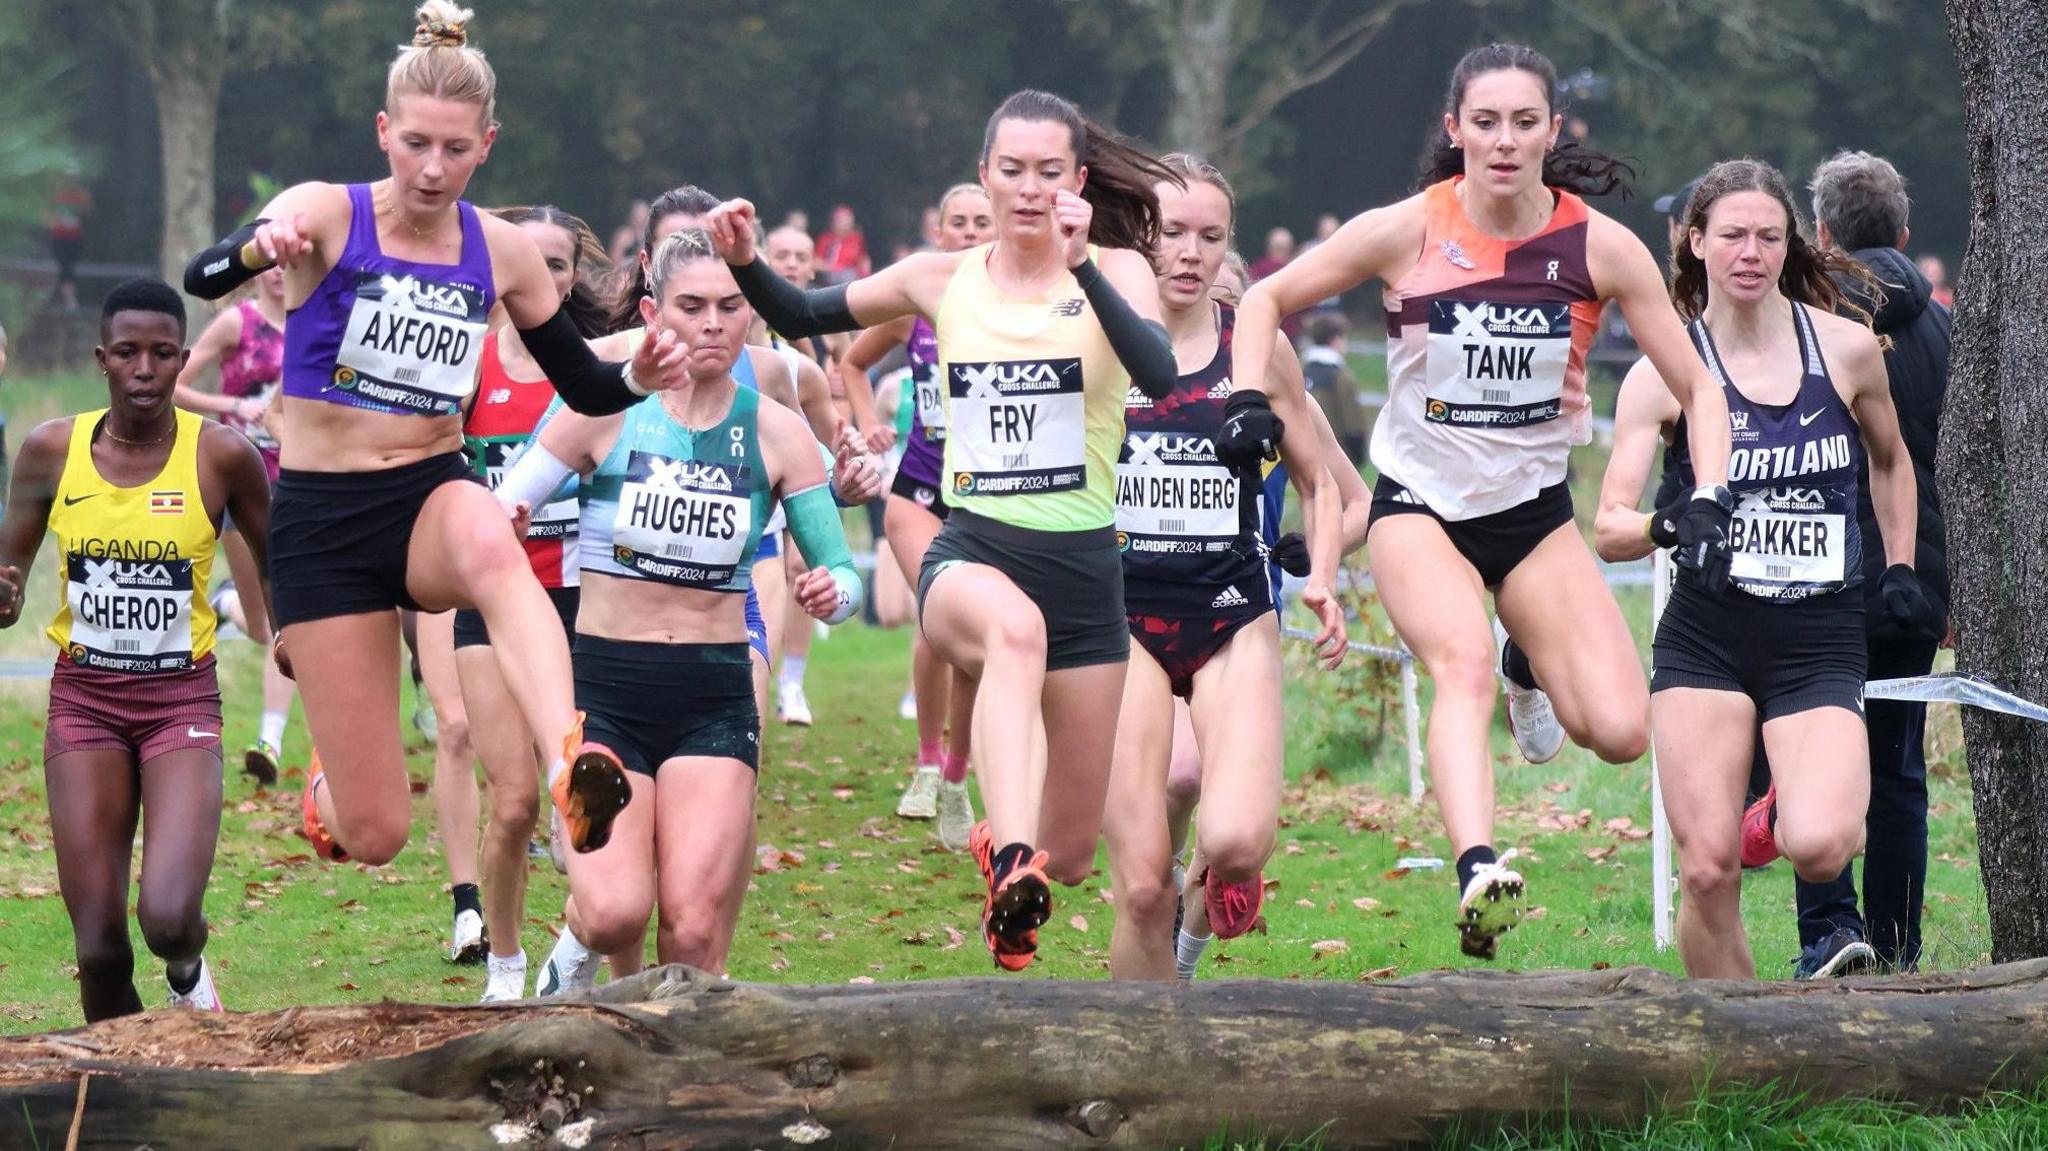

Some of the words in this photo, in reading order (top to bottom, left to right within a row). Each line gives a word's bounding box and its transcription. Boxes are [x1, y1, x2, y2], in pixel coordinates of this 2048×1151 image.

[360, 310, 470, 366] AXFORD
[1488, 324, 1510, 333] CROSS
[1511, 324, 1550, 334] CHALLENGE
[1462, 344, 1536, 381] TANK
[998, 383, 1020, 391] CROSS
[1021, 381, 1061, 390] CHALLENGE
[989, 403, 1038, 443] FRY
[1161, 452, 1182, 461] CROSS
[1183, 453, 1218, 462] CHALLENG
[1728, 434, 1851, 482] ORTLAND
[698, 480, 733, 492] CHALLENGE
[1150, 477, 1184, 509] DEN
[1190, 478, 1235, 510] BERG
[630, 492, 737, 540] HUGHES
[1770, 501, 1790, 509] CROSS
[70, 538, 179, 560] UGANDA
[1731, 517, 1828, 558] BAKKER
[116, 577, 138, 585] CROSS
[137, 577, 173, 586] CHALLENGE
[80, 591, 178, 631] CHEROP
[1212, 597, 1249, 608] adidas
